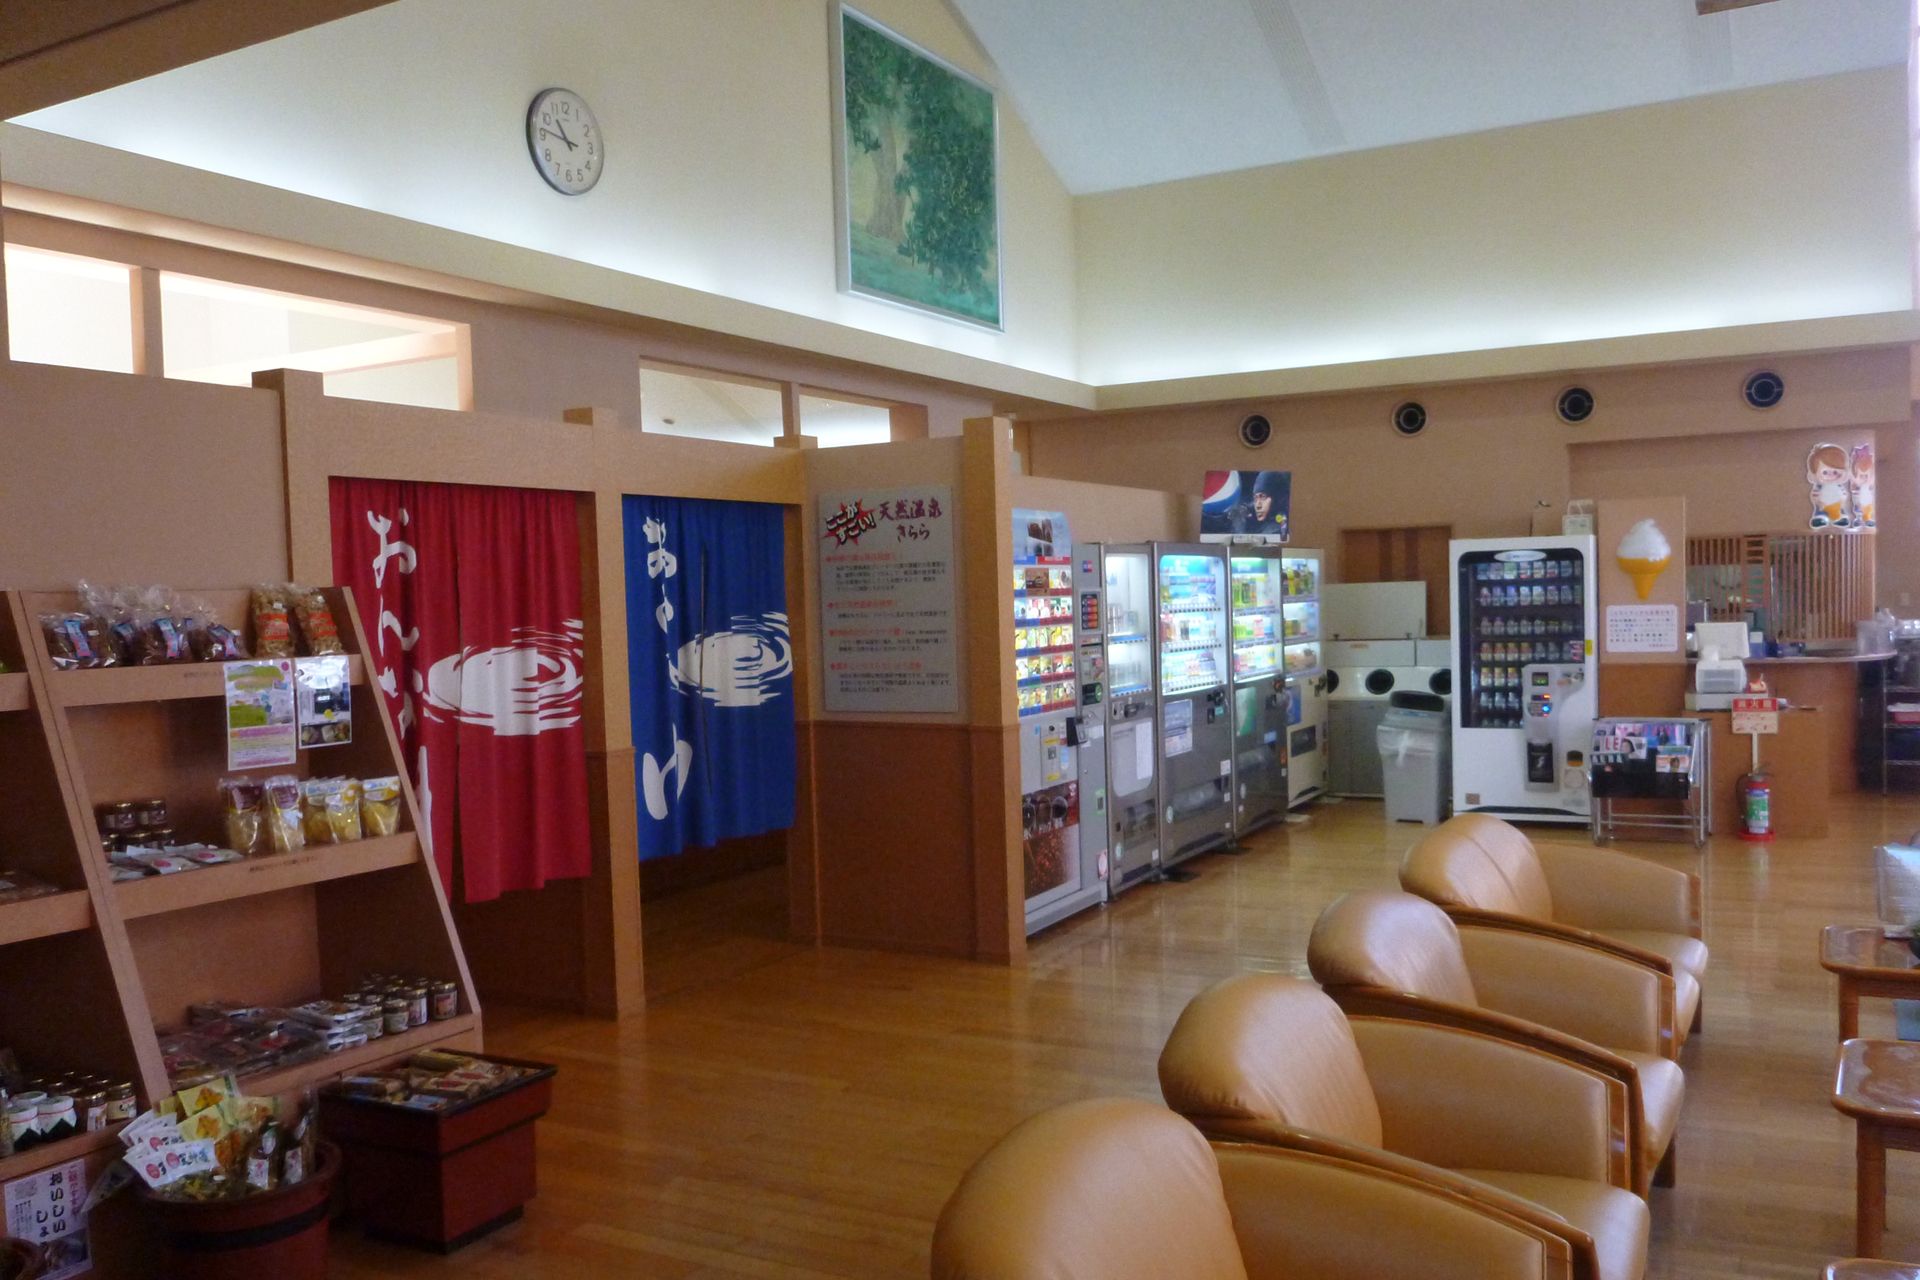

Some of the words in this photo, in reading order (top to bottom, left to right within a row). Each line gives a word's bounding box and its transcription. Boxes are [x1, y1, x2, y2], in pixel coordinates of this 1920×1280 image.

[551, 102, 559, 116] 11
[562, 101, 570, 116] 12
[576, 109, 580, 122] 1
[543, 112, 552, 126] 10
[539, 127, 547, 141] 9
[583, 125, 590, 138] 2
[545, 149, 552, 162] 8
[587, 142, 594, 155] 3
[555, 163, 561, 176] 7
[585, 160, 591, 171] 4
[566, 170, 573, 183] 6
[577, 169, 584, 182] 5
[826, 501, 859, 531] ここが
[879, 497, 942, 521] 天然温泉
[896, 523, 930, 543] きらら
[642, 516, 693, 821] おとゆ
[367, 508, 434, 858] おんな
[1605, 737, 1625, 751] LE
